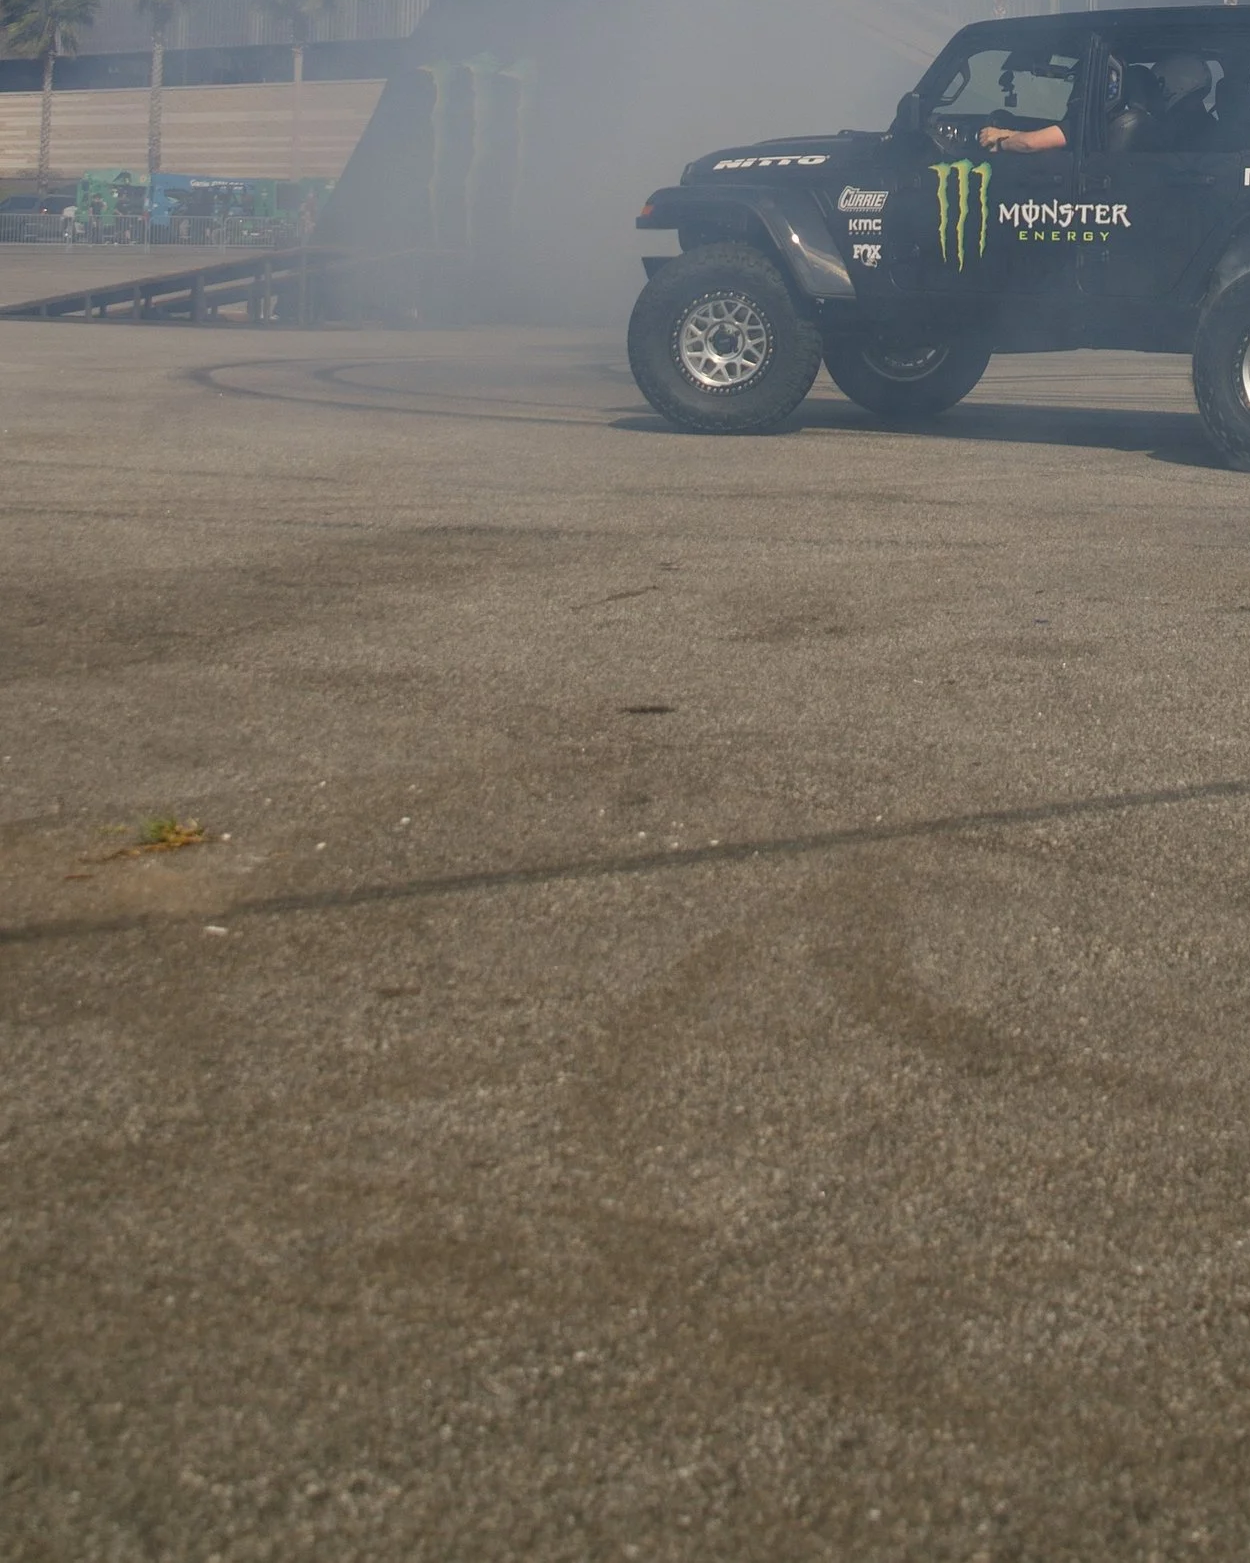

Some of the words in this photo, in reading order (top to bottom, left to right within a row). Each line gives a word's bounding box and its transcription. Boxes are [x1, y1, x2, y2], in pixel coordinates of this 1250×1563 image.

[713, 155, 827, 170] NITTO
[840, 188, 885, 209] CURRIE
[999, 199, 1131, 228] MONSTER
[848, 218, 882, 230] KMC
[1019, 231, 1110, 241] ENERGY
[852, 244, 882, 267] FOX
